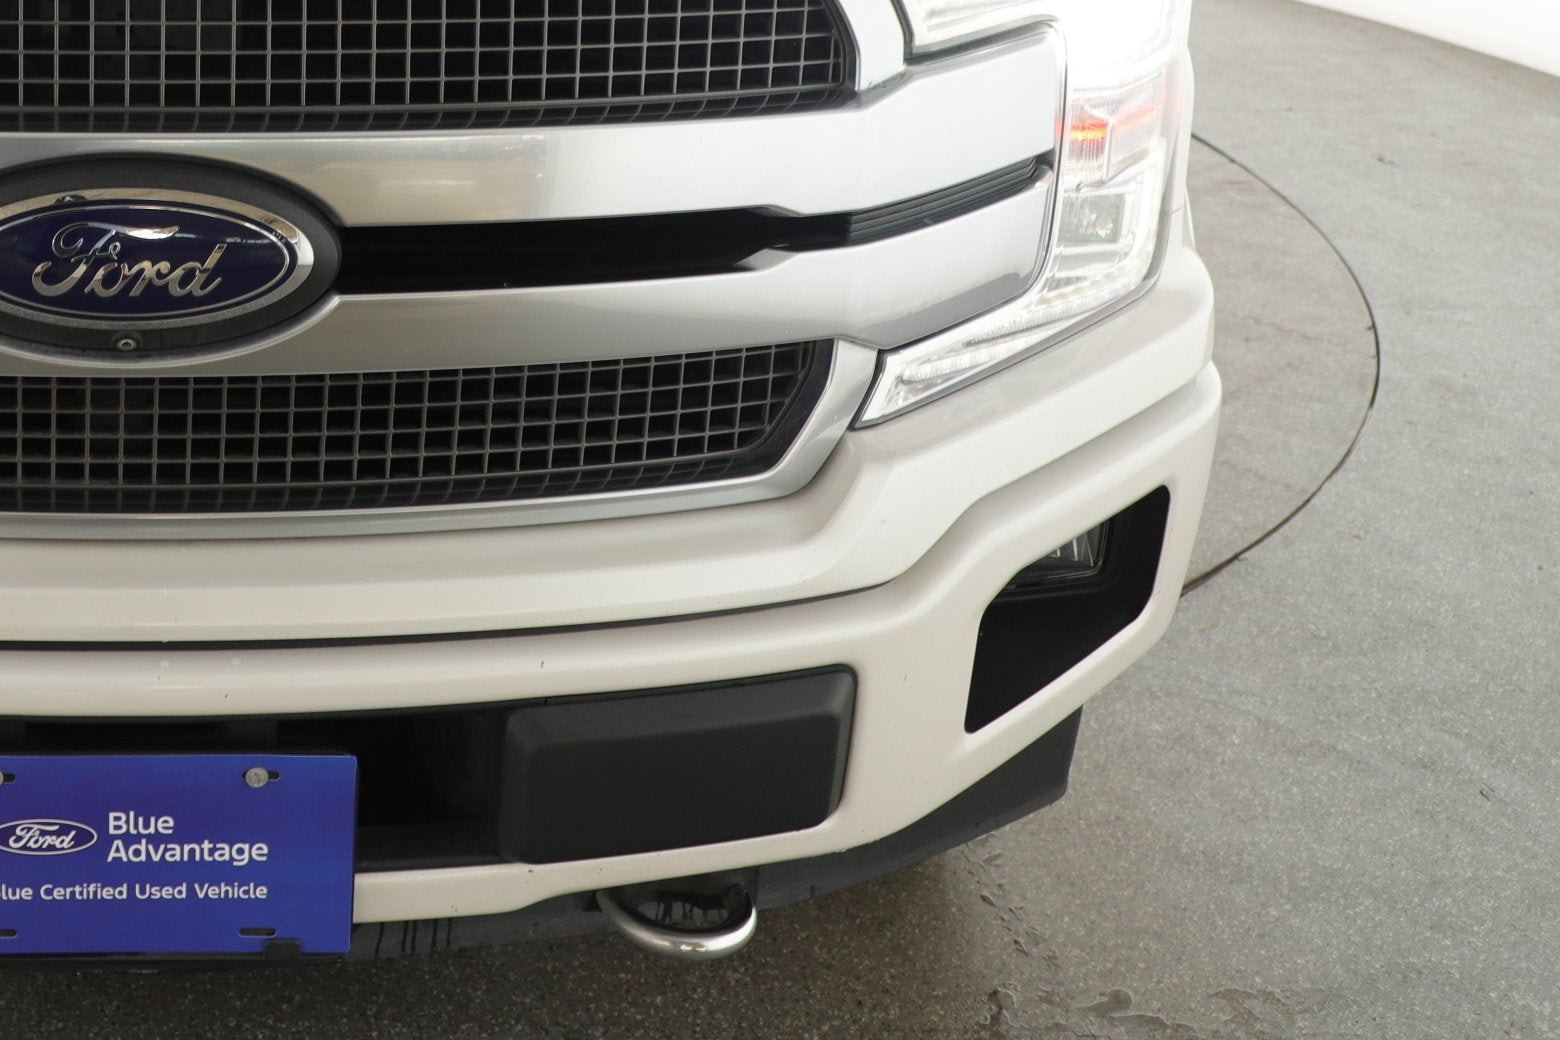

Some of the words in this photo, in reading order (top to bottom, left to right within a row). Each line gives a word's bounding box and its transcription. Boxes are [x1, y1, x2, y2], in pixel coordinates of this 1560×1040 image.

[31, 222, 228, 298] Ford
[8, 823, 76, 850] Ford
[108, 811, 174, 835] Blue
[107, 839, 269, 866] Advantage
[40, 883, 127, 900] Certified
[135, 883, 187, 900] Used
[194, 882, 268, 899] Vehicle
